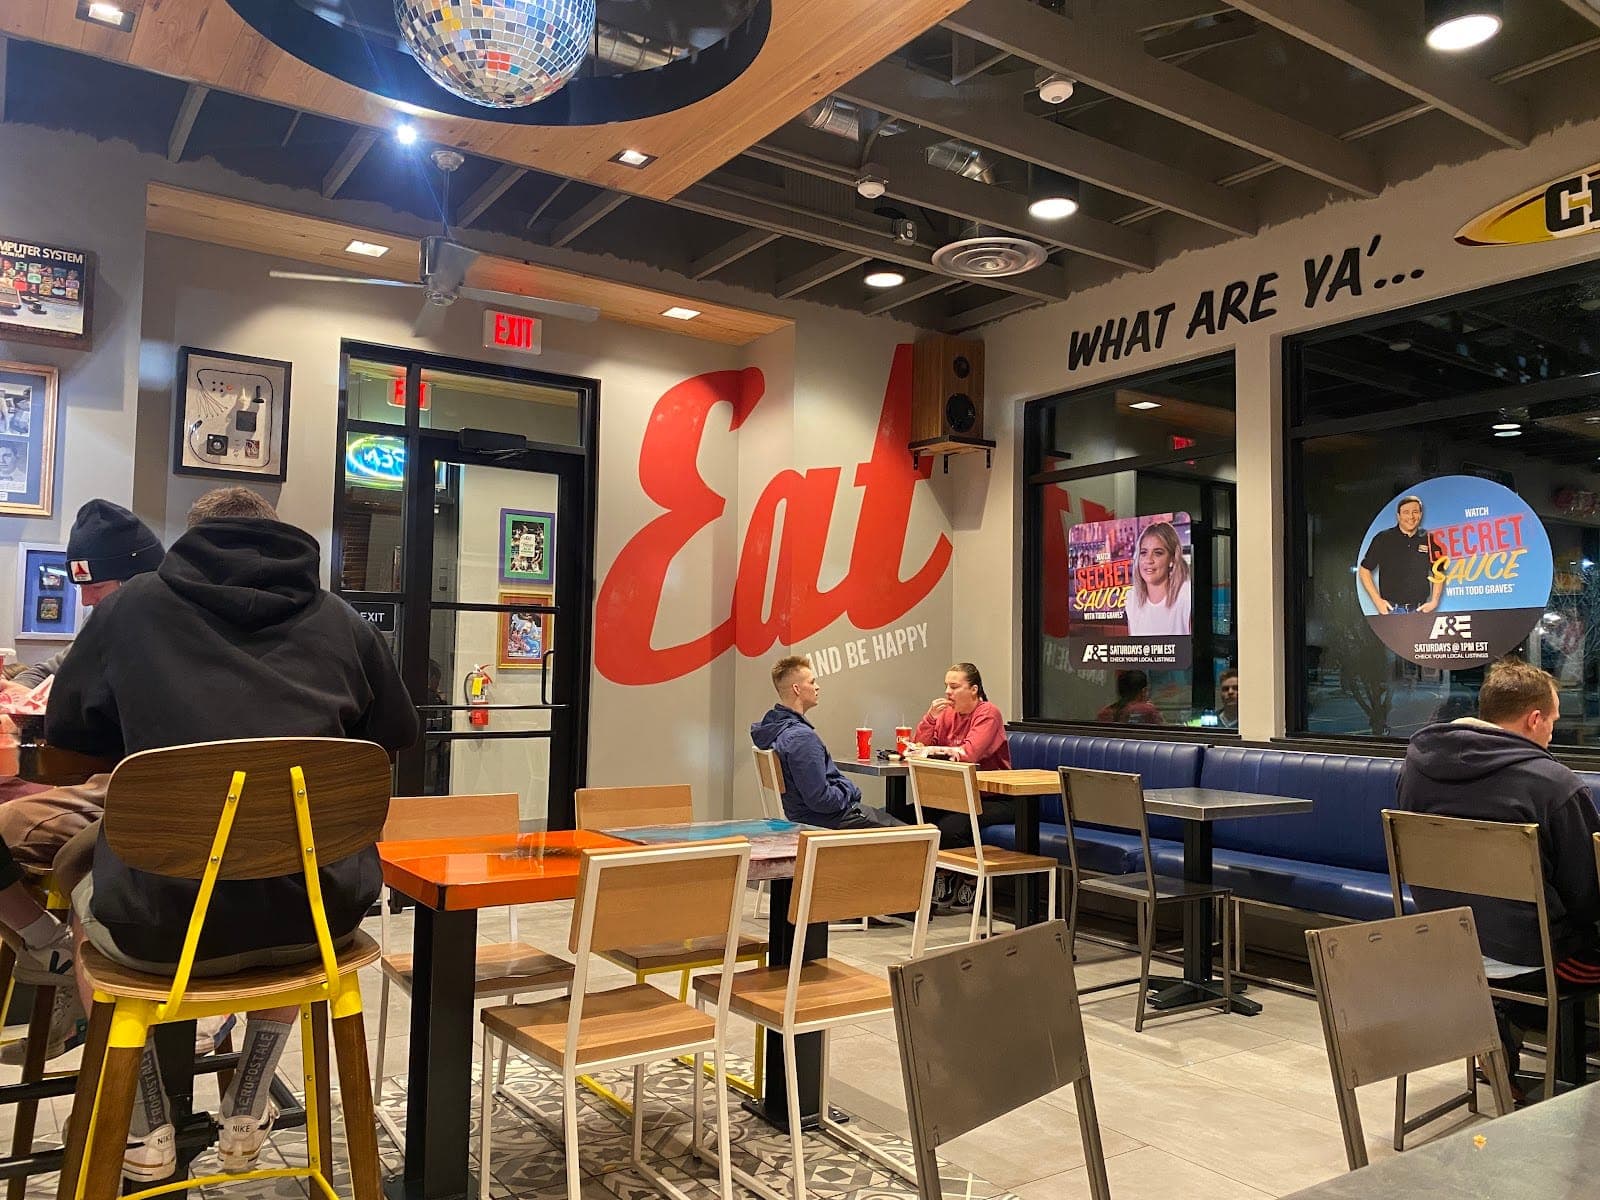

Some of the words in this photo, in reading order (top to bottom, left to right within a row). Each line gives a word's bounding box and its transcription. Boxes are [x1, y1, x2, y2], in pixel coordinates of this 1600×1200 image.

[42, 247, 83, 264] SYSTEM
[494, 313, 535, 350] EXIT
[1068, 302, 1176, 371] WHAT
[1186, 272, 1279, 339] ARE
[594, 343, 953, 686] Eat
[1464, 506, 1489, 518] WATCH
[1432, 515, 1523, 560] SECRET
[1076, 559, 1131, 592] SECRET
[1427, 548, 1528, 585] SAUCE
[1073, 585, 1134, 611] SAUCE
[1446, 587, 1464, 597] WITH
[1465, 586, 1484, 595] TODD
[360, 611, 385, 622] EXIT
[1429, 615, 1472, 640] A&E
[844, 638, 870, 669] BE
[871, 622, 909, 662] HAPPY
[1082, 644, 1108, 663] A&E
[1109, 644, 1143, 656] SATURDAYS
[1143, 644, 1151, 657] @
[1151, 645, 1164, 655] 1PM
[1164, 644, 1176, 655] EST
[1414, 642, 1452, 653] SATURDAYS
[1452, 642, 1460, 652] @
[1460, 642, 1474, 652] 1PM
[1475, 641, 1489, 652] EST
[232, 1125, 250, 1133] NIKE
